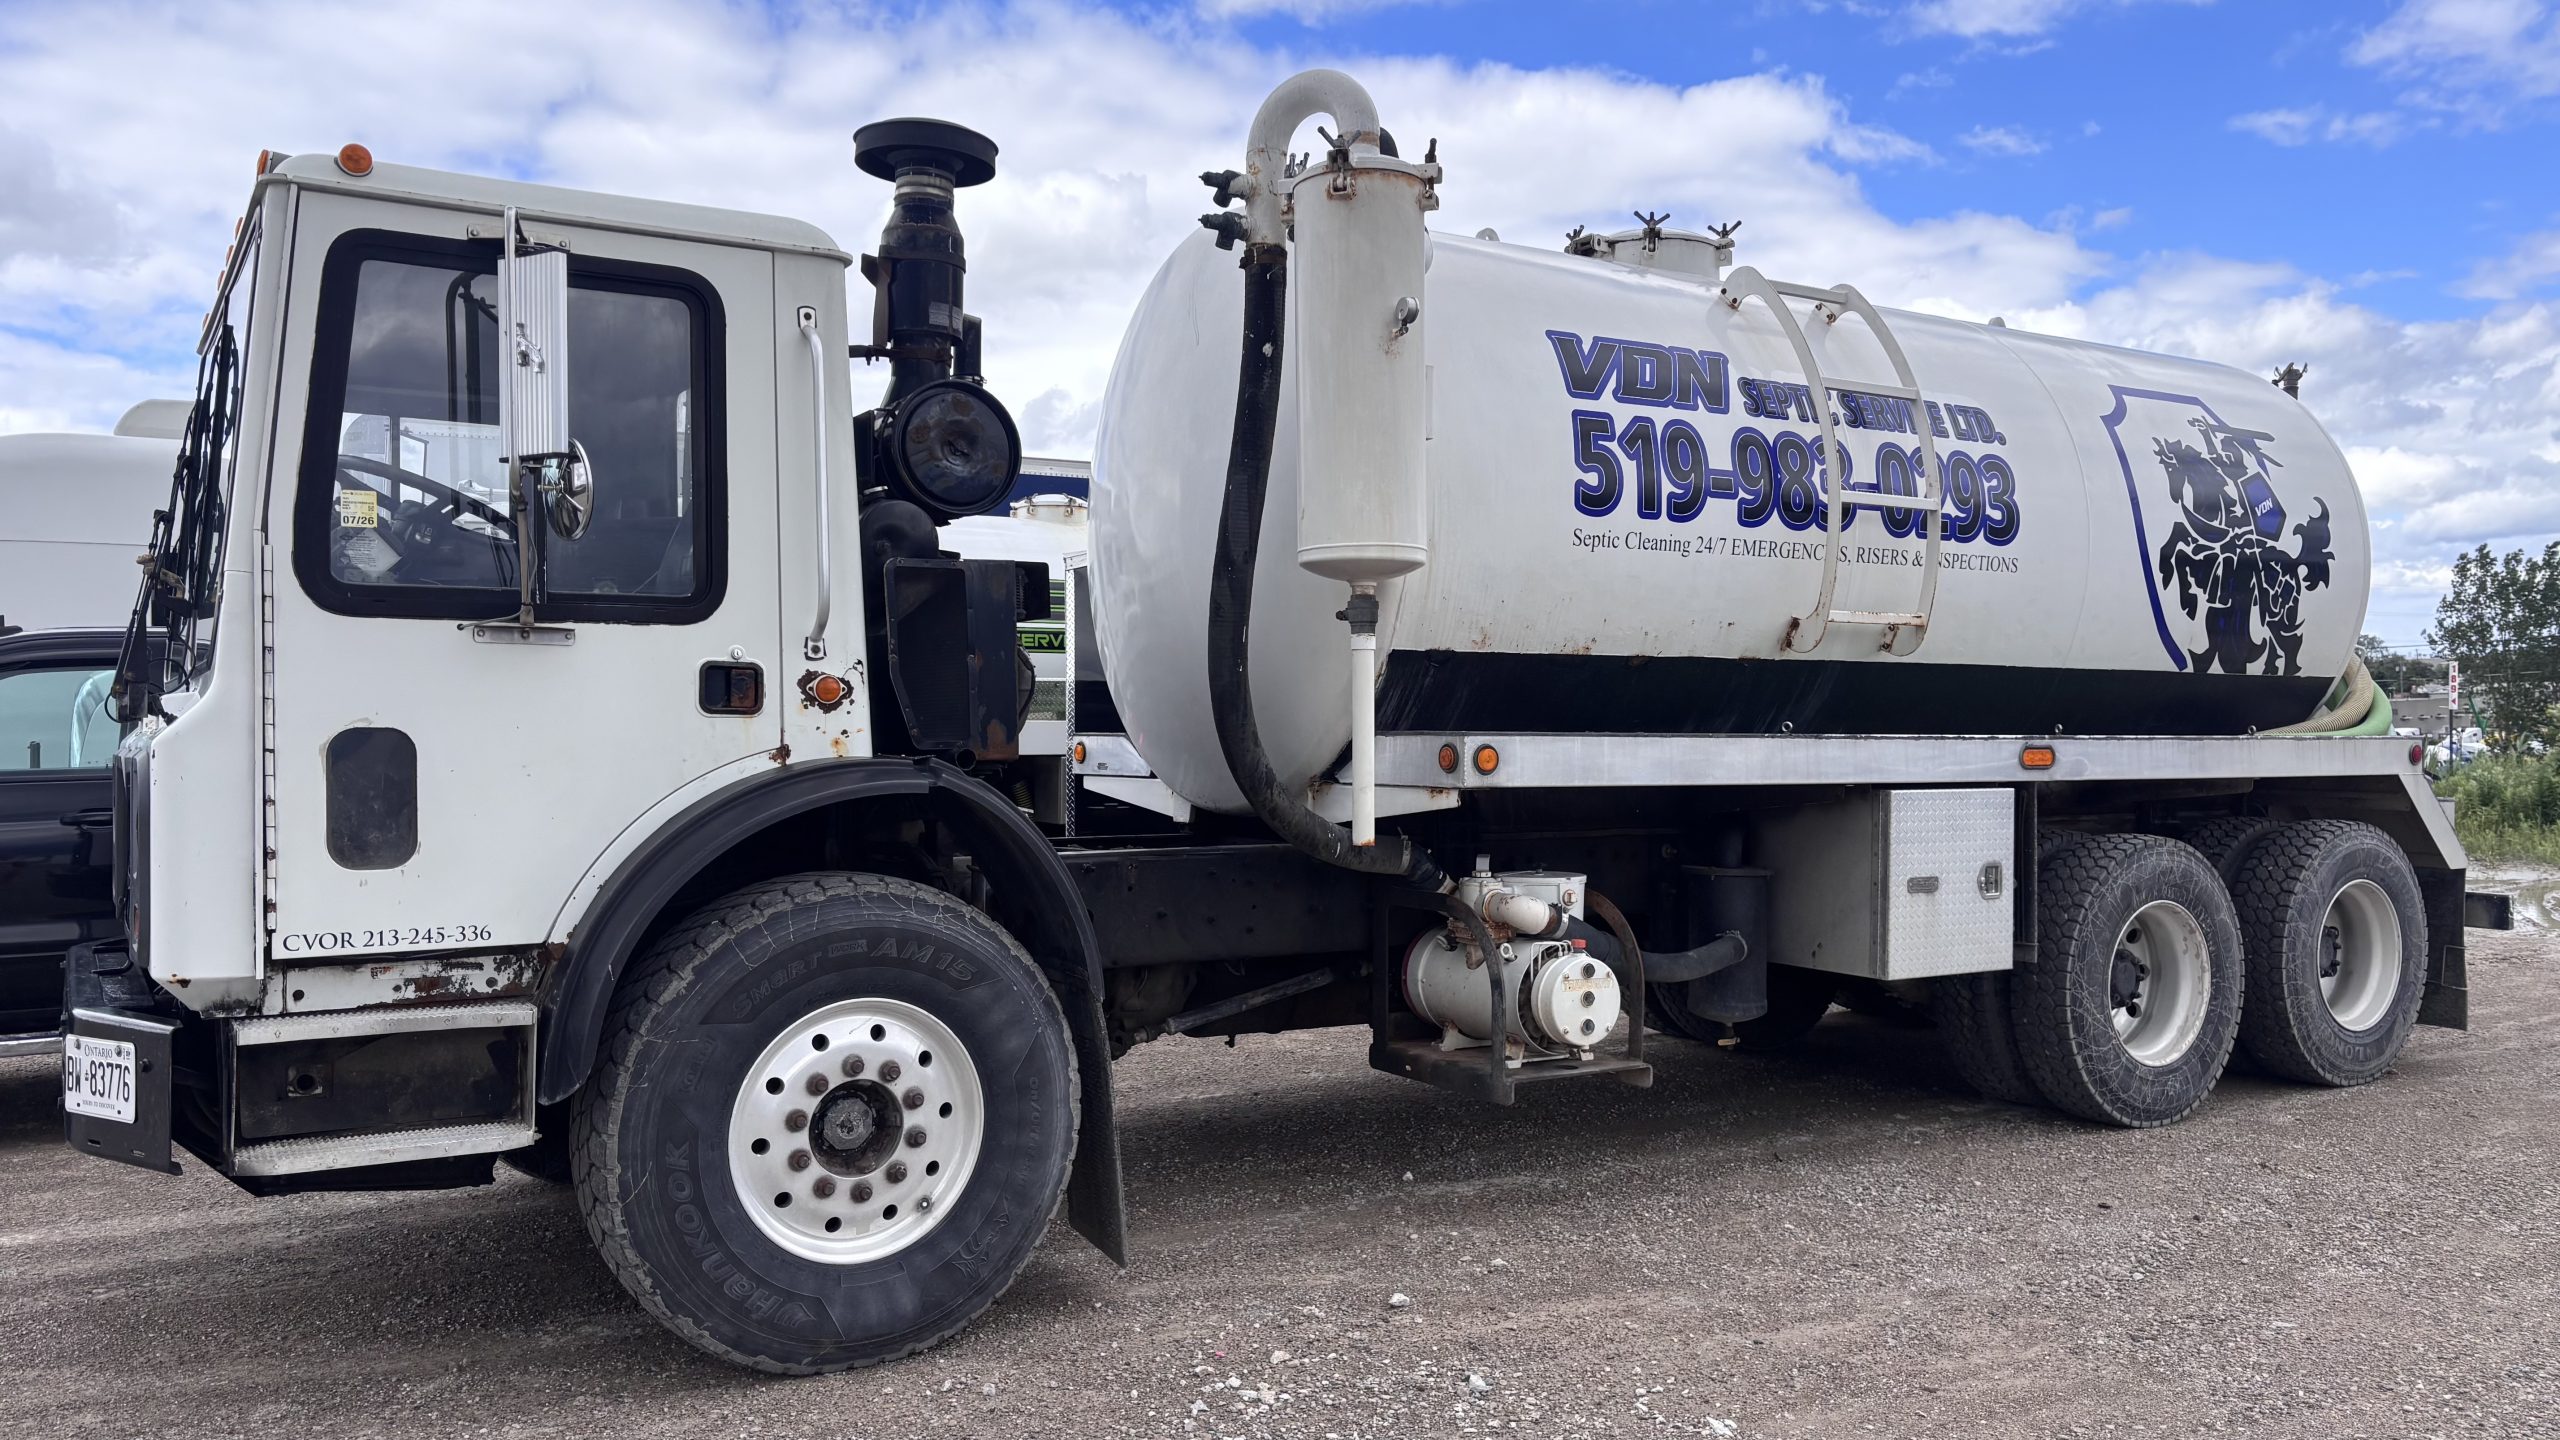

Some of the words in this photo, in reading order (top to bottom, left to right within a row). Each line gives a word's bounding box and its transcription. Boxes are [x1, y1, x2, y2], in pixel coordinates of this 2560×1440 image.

[1545, 329, 1729, 414] VDN
[1737, 377, 1840, 427] SEPTI
[1837, 391, 1949, 439] SERVIE
[1943, 403, 2006, 446] LTD.
[1571, 409, 2020, 546] 519-983-0293
[342, 515, 375, 525] 07/26
[2254, 497, 2274, 517] VDN
[1572, 528, 1620, 552] Septic
[1625, 531, 1691, 557] Cleaning
[1695, 536, 1727, 555] 24/7
[1731, 538, 1851, 566] EMERGENCS,
[1856, 546, 1908, 566] RISERS
[1911, 550, 1924, 567] &
[1938, 552, 2019, 573] NSPECTIONS
[282, 932, 357, 951] CVOR
[362, 924, 492, 948] 213-245-336
[84, 1044, 113, 1059] ONTARIO
[90, 1059, 131, 1103] 83776
